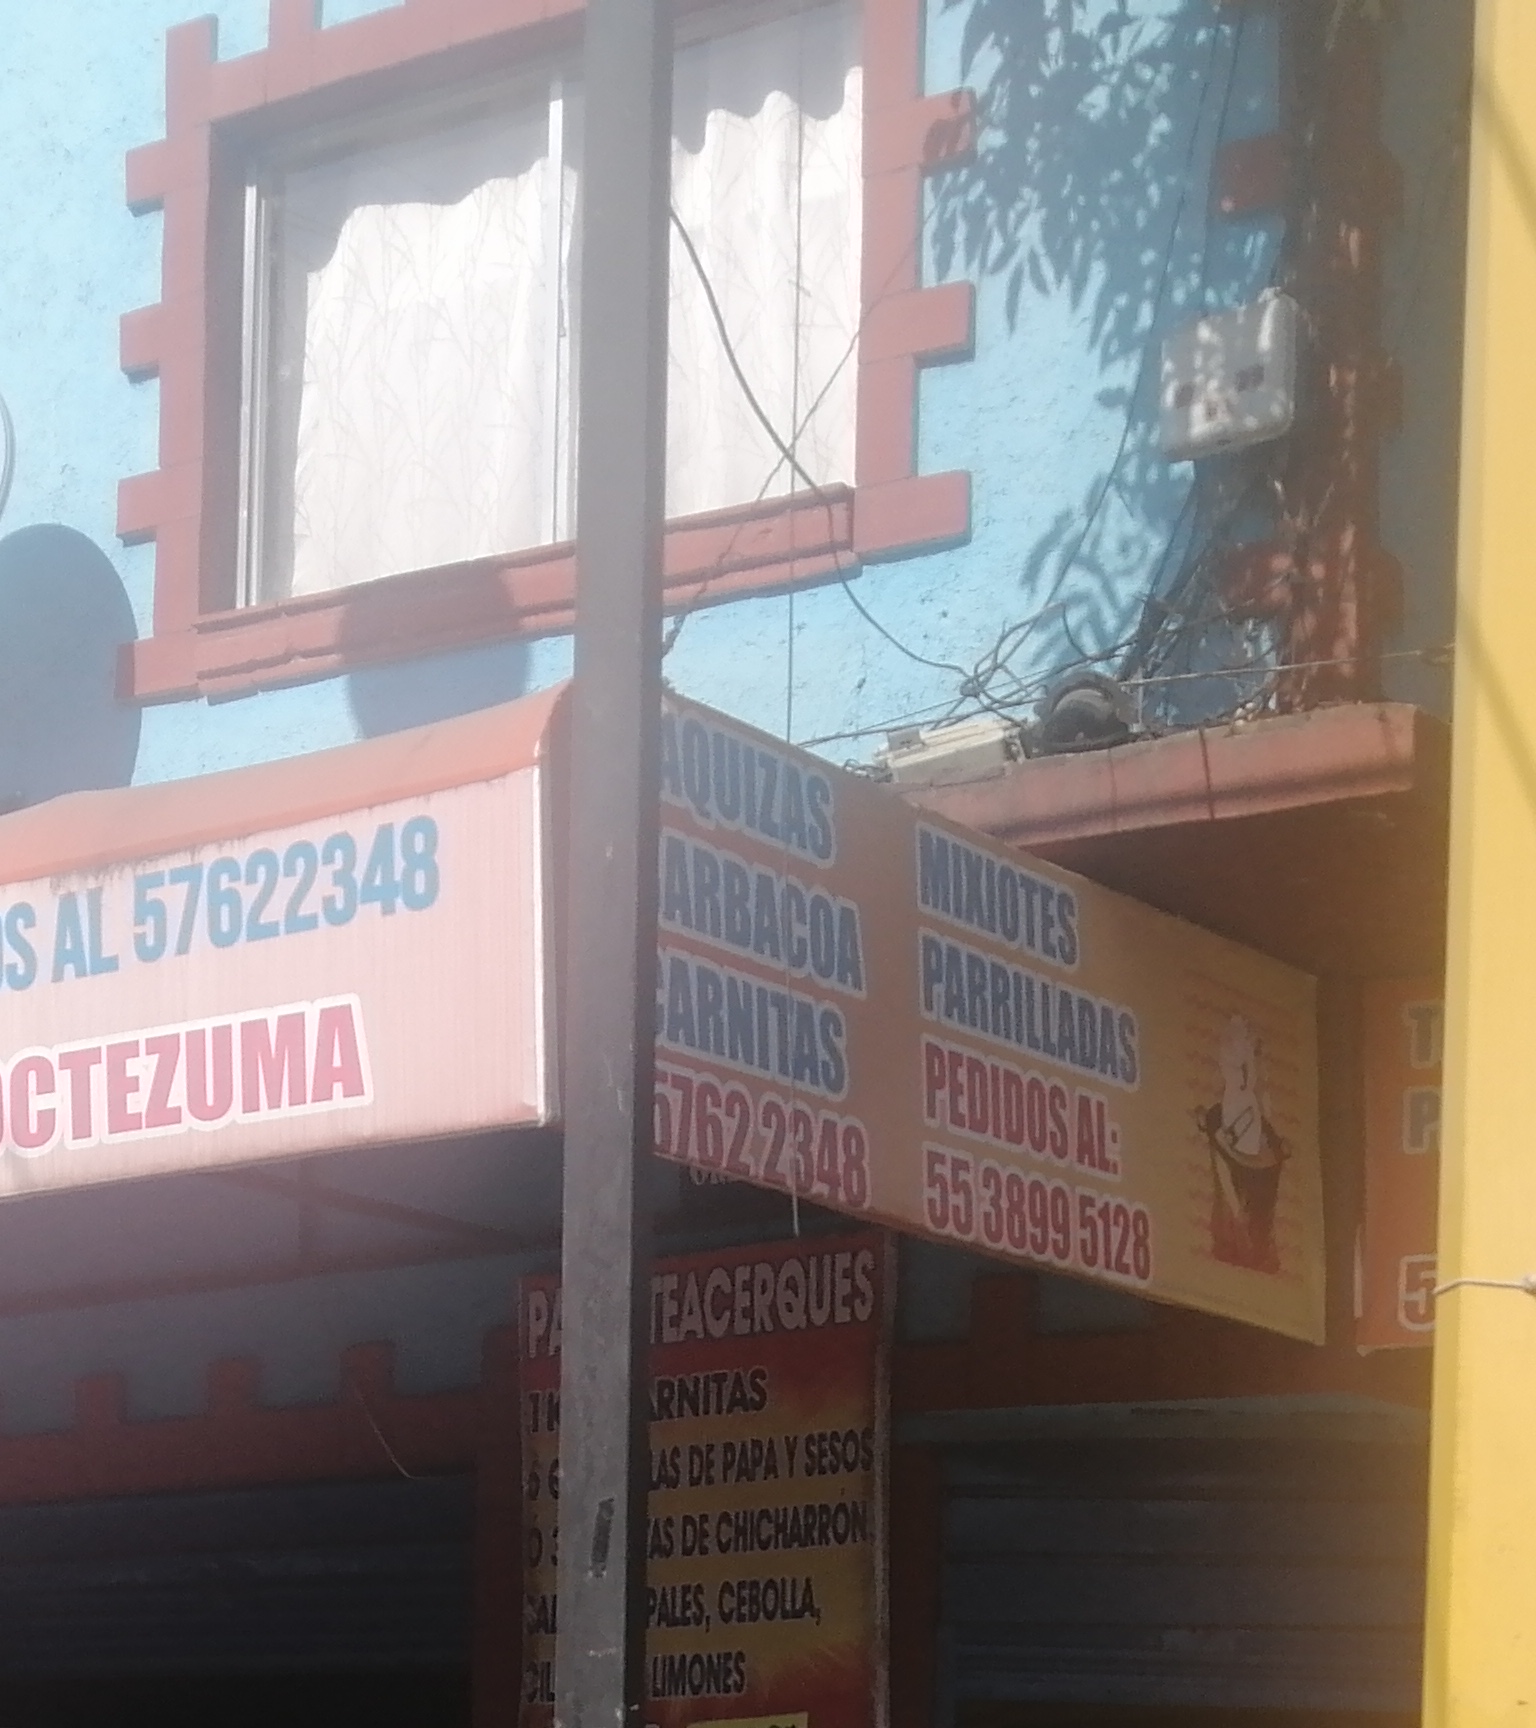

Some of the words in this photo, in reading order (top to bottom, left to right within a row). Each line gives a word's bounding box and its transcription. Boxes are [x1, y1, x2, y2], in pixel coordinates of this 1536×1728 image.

[660, 712, 835, 862] AQUIZAS
[52, 890, 119, 984] AL
[133, 814, 441, 965] 57622348
[661, 833, 864, 993] ARBACOA
[918, 828, 1078, 966] MIXIOTES
[656, 954, 847, 1097] ARNITAS
[921, 932, 1139, 1086] PARRILLADAS
[654, 1069, 752, 1177] 5762
[760, 1098, 868, 1208] 2348
[924, 1041, 1069, 1161] PEDIDOS
[1075, 1092, 1121, 1176] AL:
[925, 1148, 974, 1238] 55
[981, 1164, 1071, 1262] 3899
[1077, 1197, 1151, 1282] 5128
[649, 1367, 769, 1422] RNITAS
[689, 1442, 715, 1486] DE
[721, 1436, 779, 1484] PAPA
[783, 1435, 799, 1479] Y
[804, 1426, 876, 1479] SESOS
[681, 1511, 710, 1558] DE
[715, 1499, 870, 1553] CHICHARRON
[646, 1583, 711, 1633] PALES,
[717, 1576, 822, 1627] CEBOLLA,
[650, 1650, 747, 1699] LIMONES
